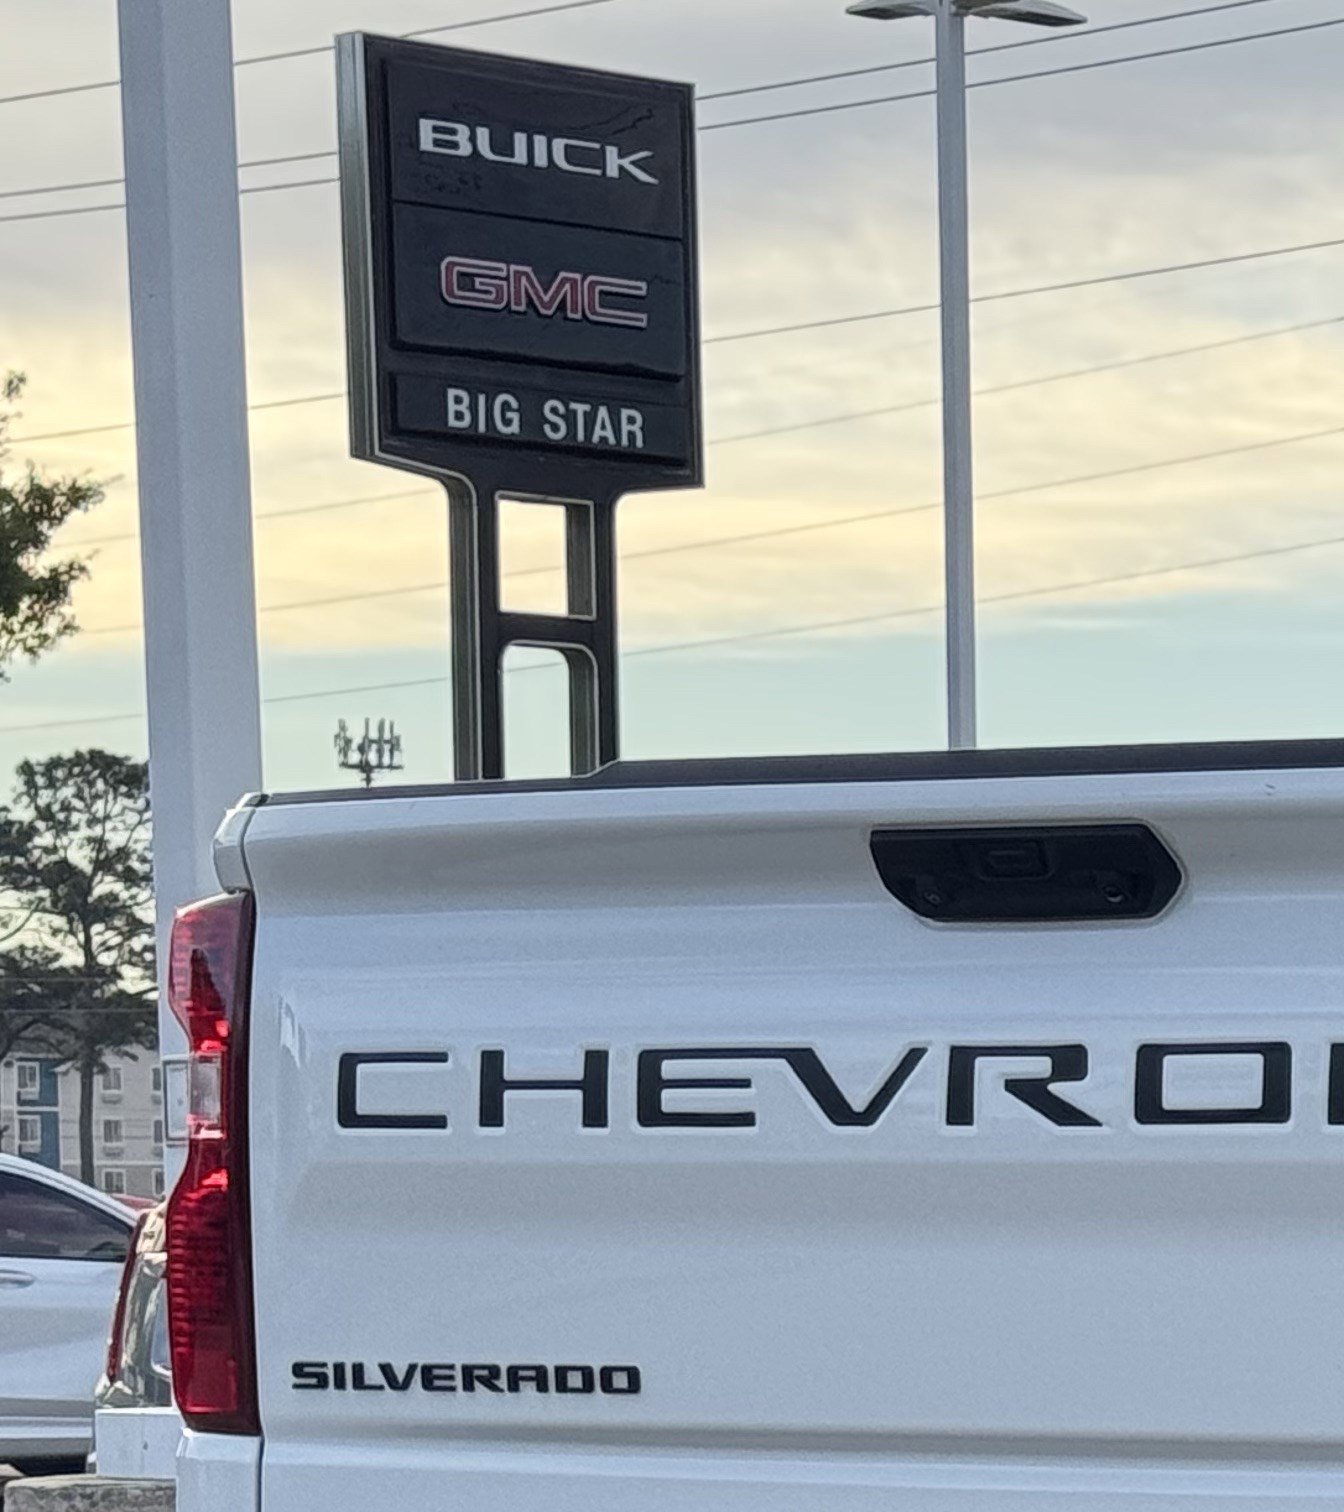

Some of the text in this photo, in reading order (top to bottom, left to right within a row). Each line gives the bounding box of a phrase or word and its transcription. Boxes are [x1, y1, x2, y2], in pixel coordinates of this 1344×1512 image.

[419, 117, 659, 185] BUICK
[440, 256, 648, 328] GMC
[447, 387, 644, 448] BIG STAR
[291, 1360, 642, 1396] SILVERADO
